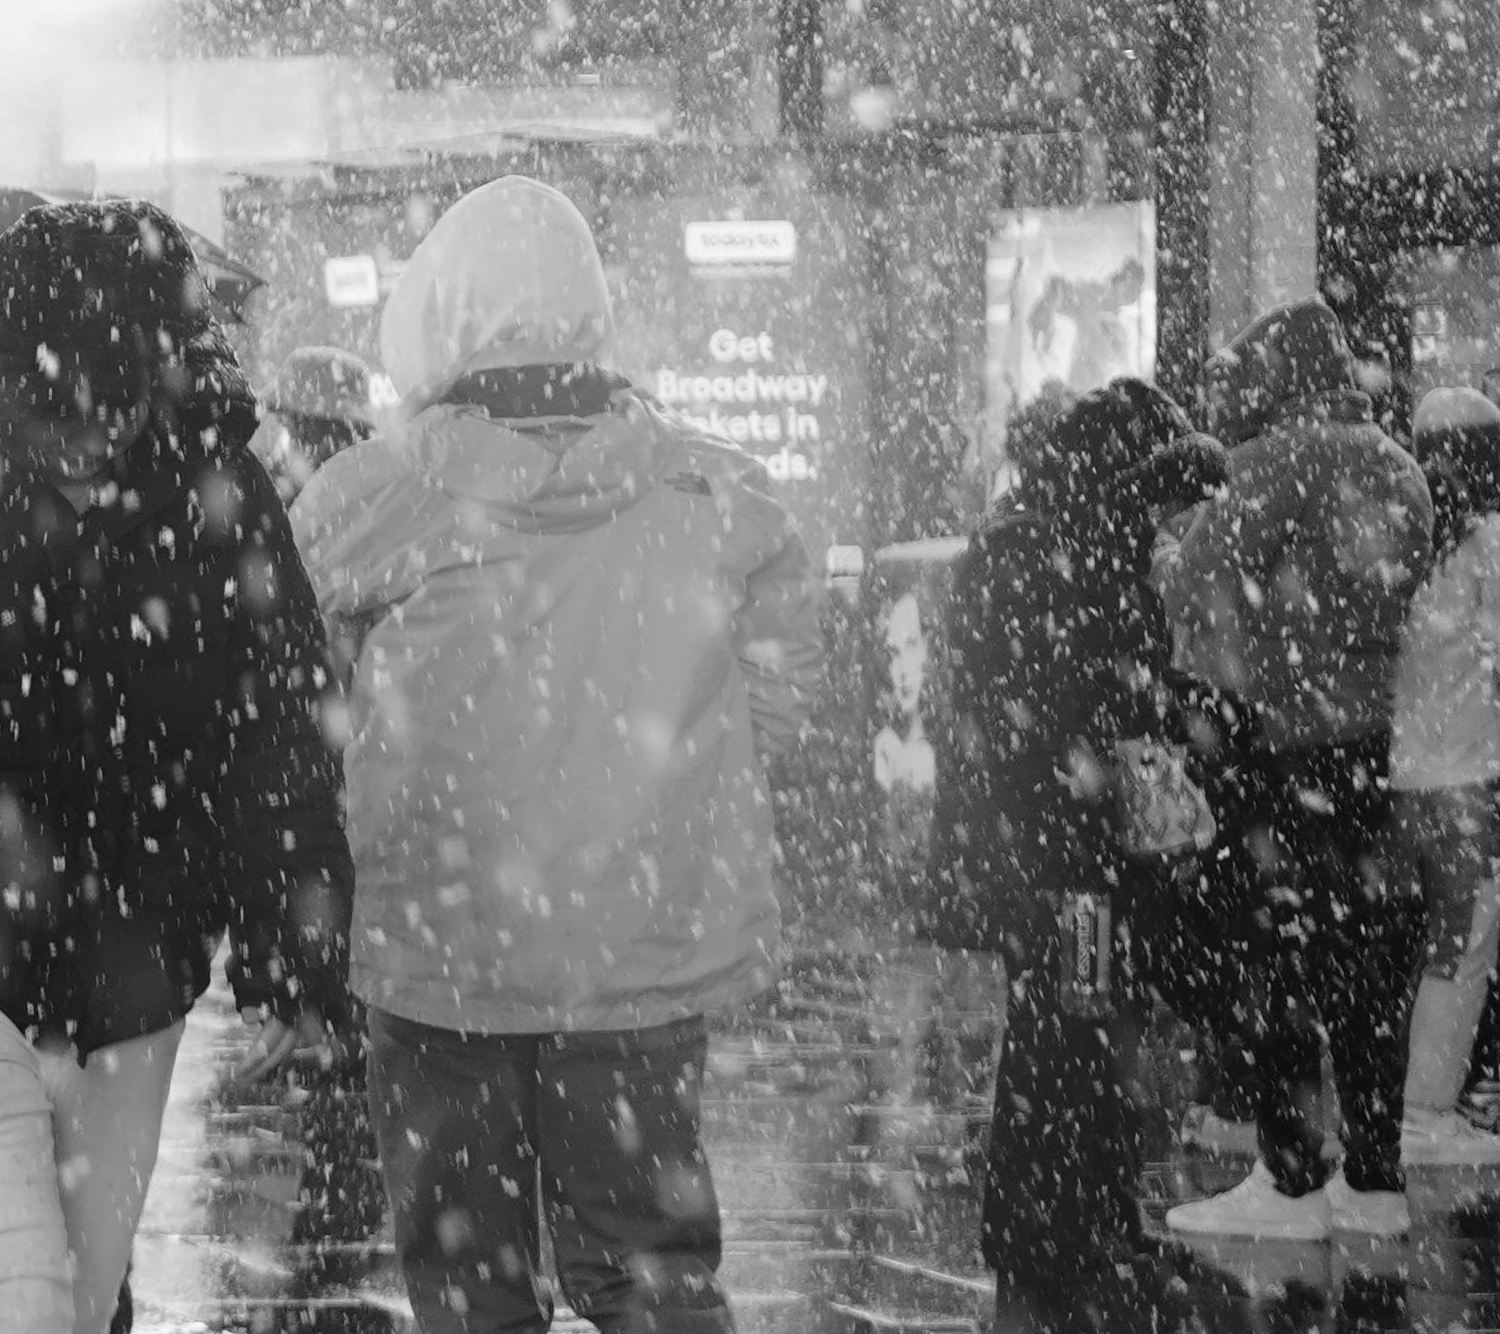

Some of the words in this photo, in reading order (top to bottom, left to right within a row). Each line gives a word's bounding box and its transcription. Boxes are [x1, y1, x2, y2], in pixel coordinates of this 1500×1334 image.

[709, 329, 775, 363] Get
[656, 367, 828, 406] Broadway
[788, 406, 820, 442] in
